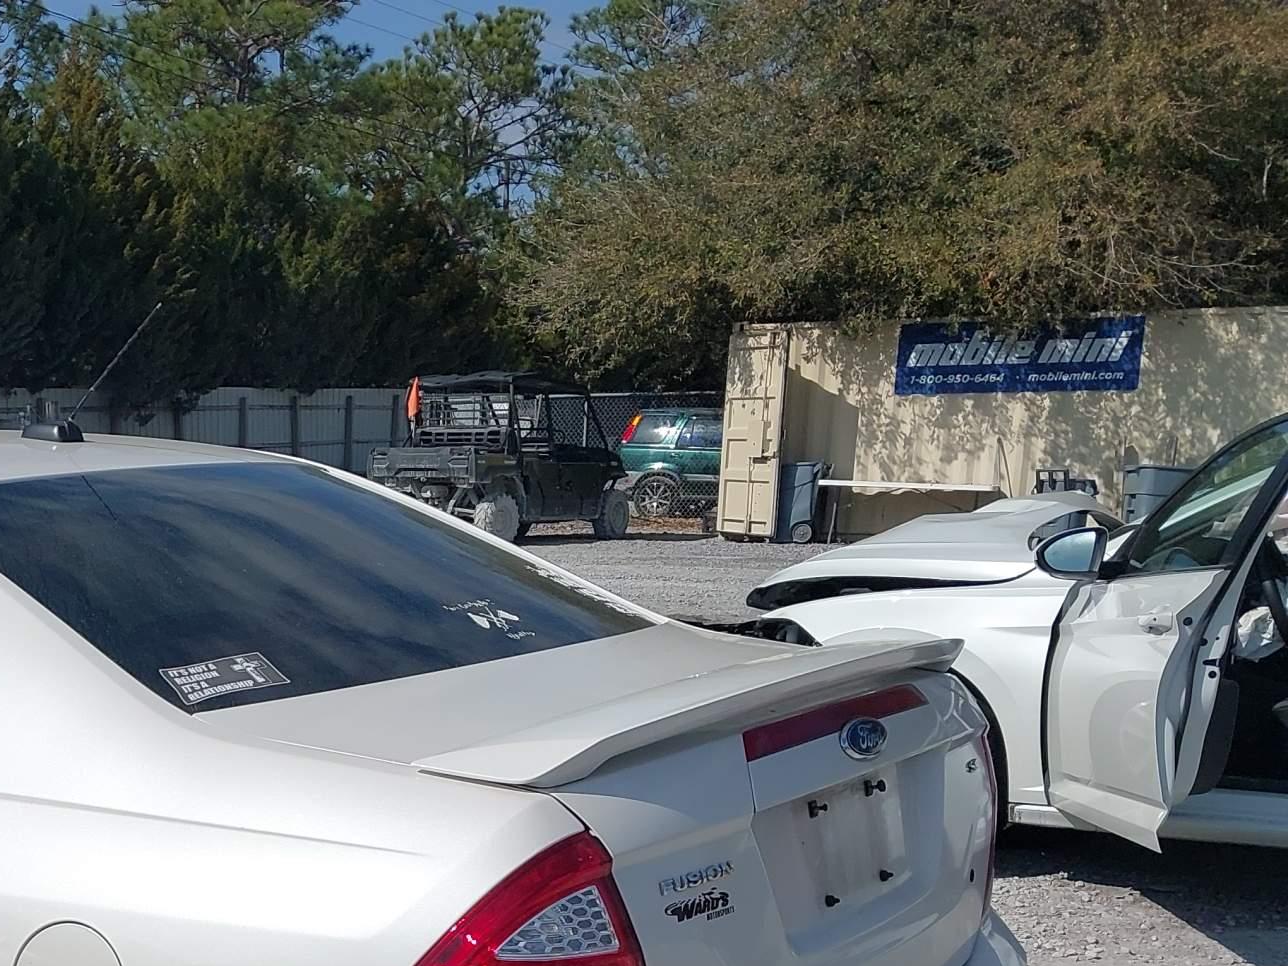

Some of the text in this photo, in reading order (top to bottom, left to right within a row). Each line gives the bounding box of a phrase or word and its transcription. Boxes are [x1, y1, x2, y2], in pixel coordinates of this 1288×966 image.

[907, 330, 1133, 367] mobile mini
[910, 370, 1124, 385] 1-800-950-6464 mobilemini.com
[174, 670, 220, 686] RELIGION
[188, 664, 208, 674] NOT
[188, 680, 255, 701] RELATIONSHIP
[858, 725, 887, 748] Ford
[659, 860, 735, 896] FUSION
